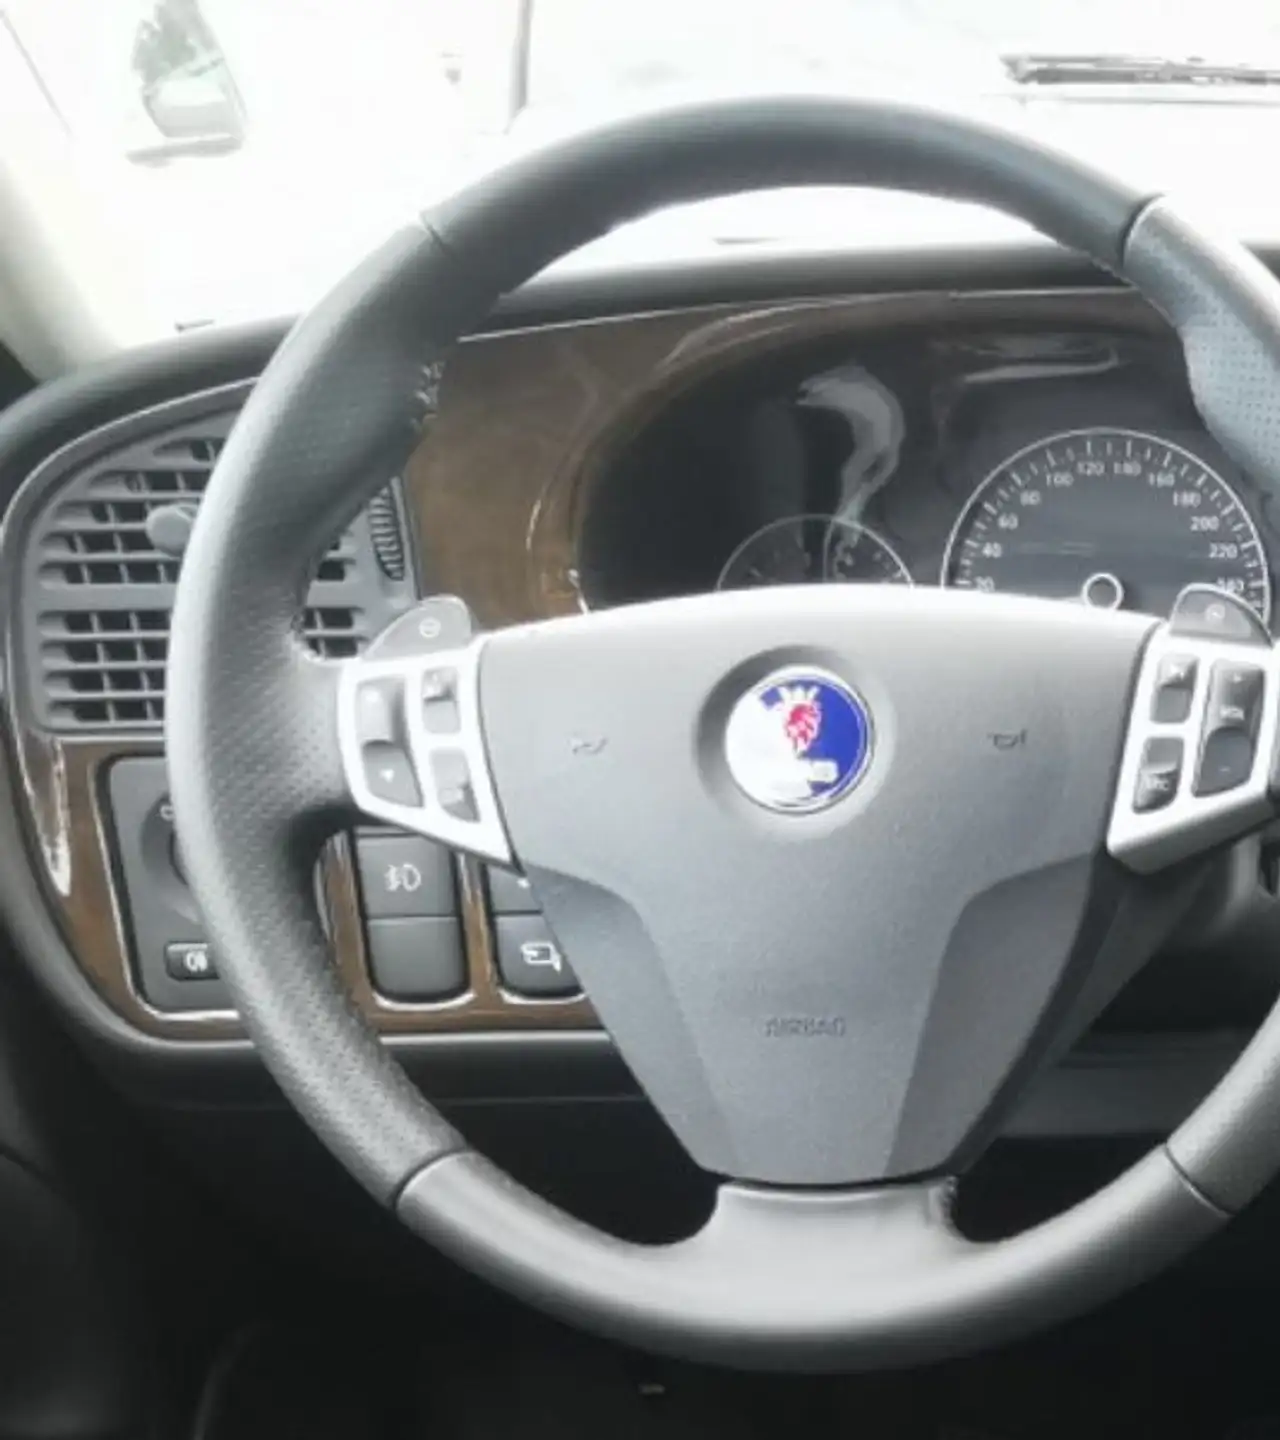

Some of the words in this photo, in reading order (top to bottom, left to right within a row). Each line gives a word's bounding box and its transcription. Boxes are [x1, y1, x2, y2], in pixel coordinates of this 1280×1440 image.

[1045, 471, 1075, 489] 100
[1190, 515, 1220, 532] 200
[1208, 541, 1238, 559] 220
